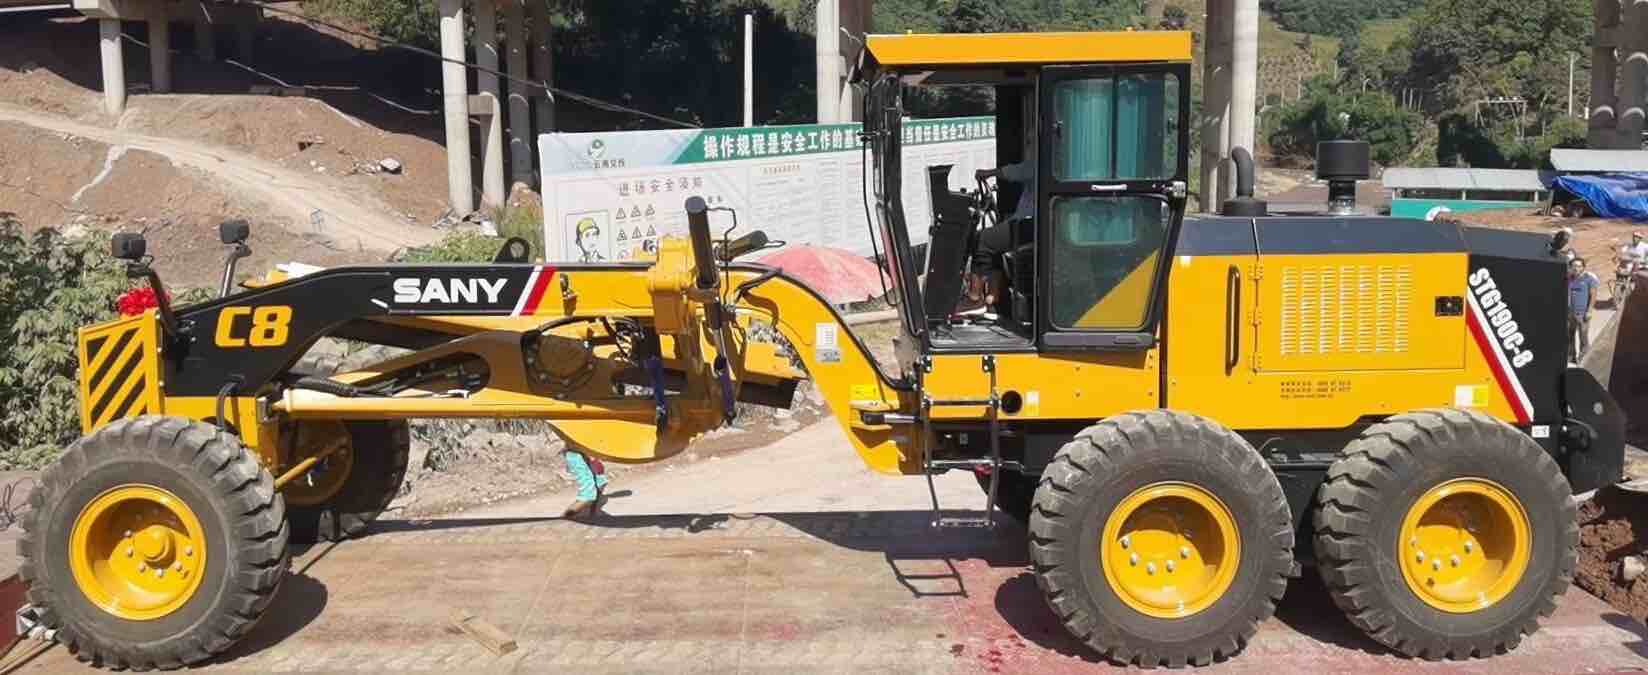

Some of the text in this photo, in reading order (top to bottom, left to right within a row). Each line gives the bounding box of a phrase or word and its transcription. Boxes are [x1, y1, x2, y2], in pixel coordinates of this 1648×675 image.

[901, 121, 994, 144] 当责任是安全工作的灵
[393, 278, 508, 303] SANY
[214, 305, 292, 347] C8
[1469, 267, 1533, 368] STG190C-8
